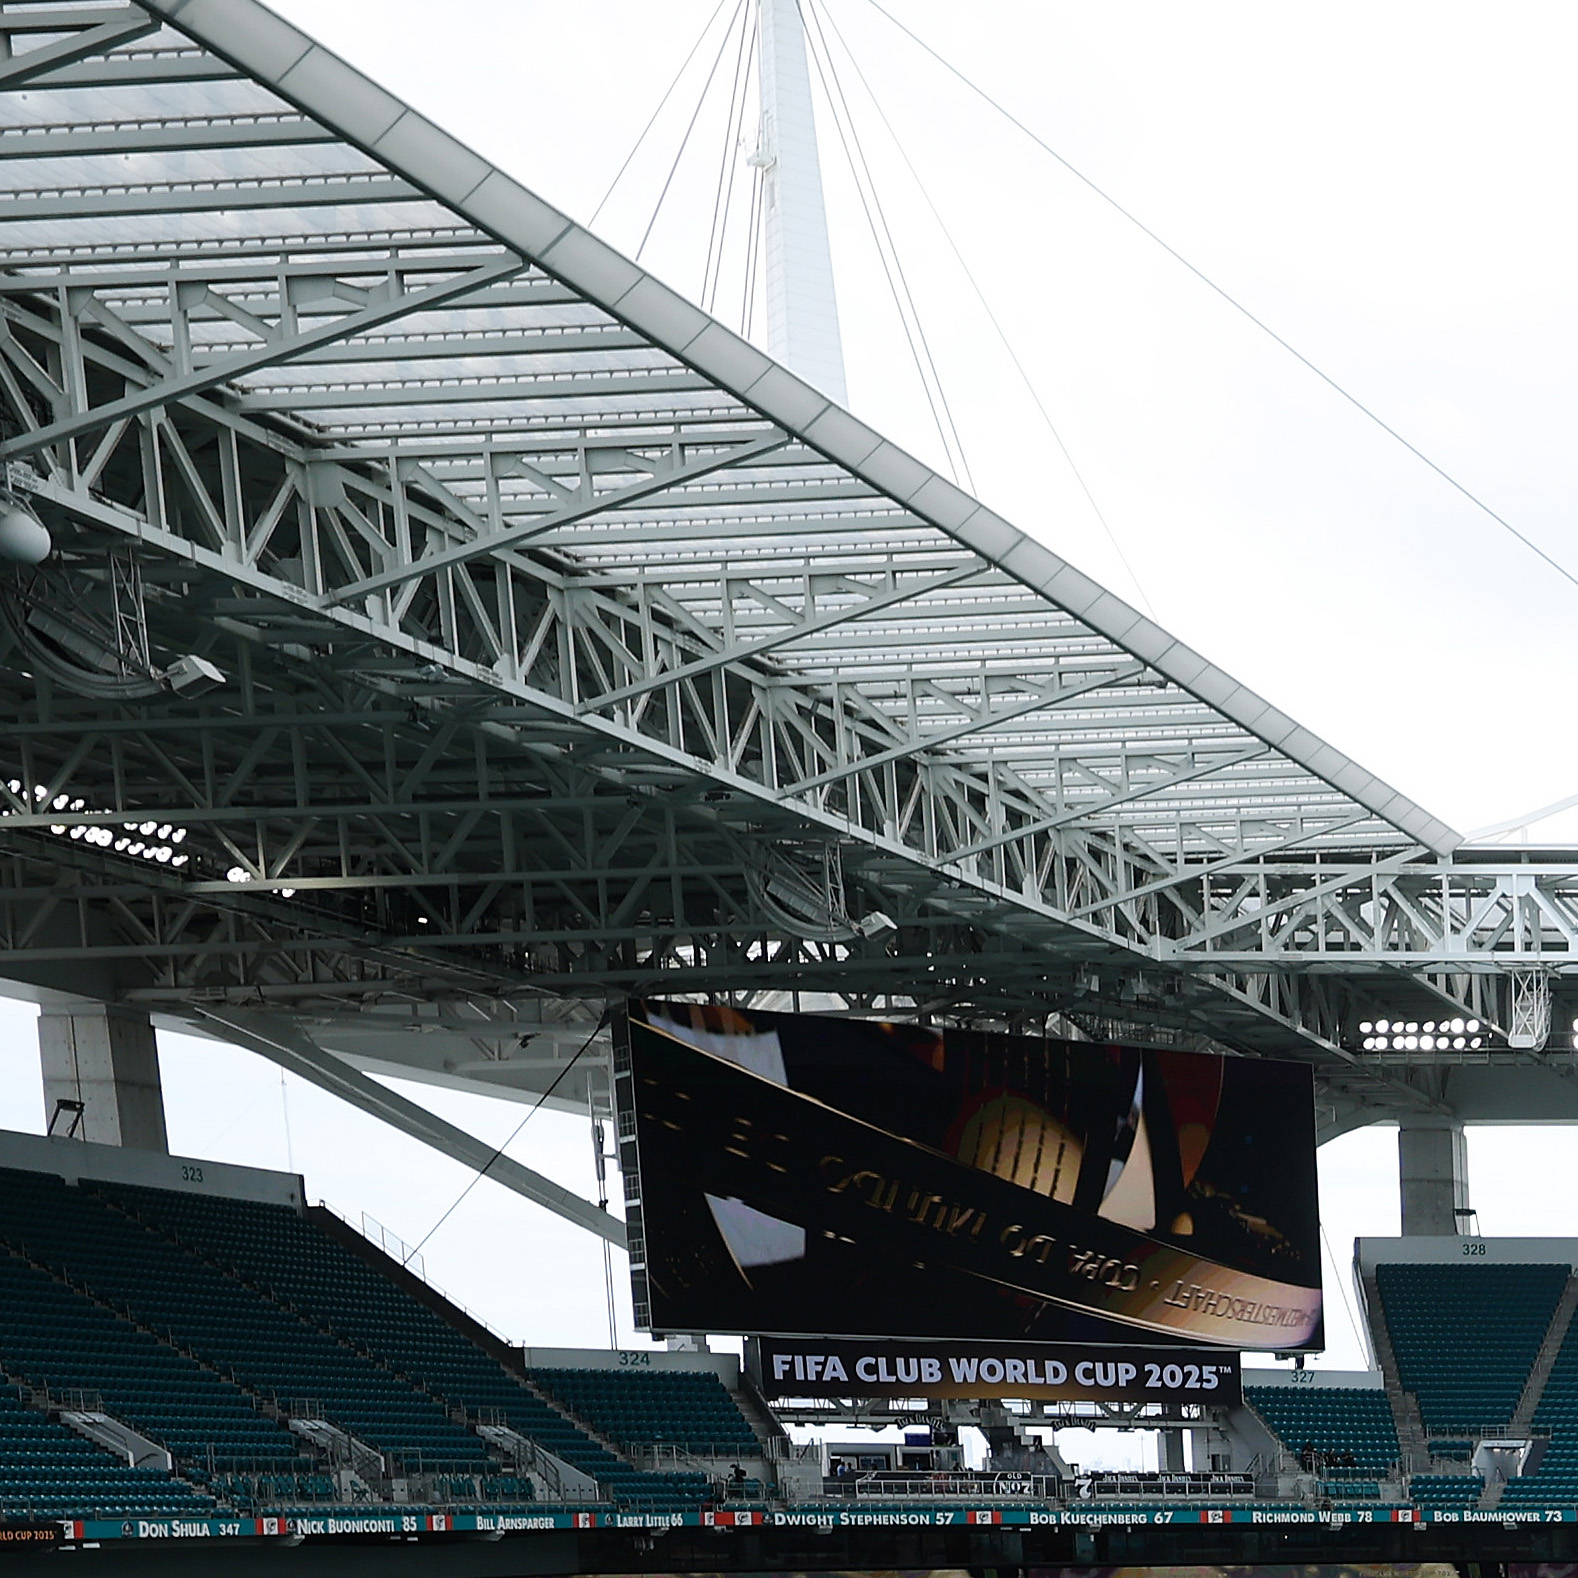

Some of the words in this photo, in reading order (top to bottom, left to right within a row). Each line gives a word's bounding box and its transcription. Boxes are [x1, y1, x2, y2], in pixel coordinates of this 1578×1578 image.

[182, 1166, 203, 1183] 323
[1462, 1244, 1486, 1256] 328
[618, 1352, 650, 1366] 324
[772, 1354, 848, 1382] FIFA
[856, 1356, 942, 1383] CLUB
[948, 1357, 1067, 1385] WORLD
[1074, 1361, 1137, 1388] CUP
[1291, 1371, 1315, 1384] 327
[1074, 1477, 1094, 1499] 7
[476, 1515, 496, 1530] BILL
[497, 1514, 555, 1530] ARNSPARGER
[617, 1513, 644, 1528] LARRY
[645, 1513, 670, 1528] LITTLE
[670, 1513, 683, 1526] 66
[774, 1513, 834, 1526] DWIGHT
[840, 1513, 930, 1526] STEPHENSON
[935, 1512, 954, 1525] 57
[1030, 1513, 1056, 1525] BOB
[1060, 1511, 1147, 1525] KUECHENBERG
[1153, 1511, 1173, 1524] 67
[1252, 1512, 1315, 1523] RICHMOND
[1318, 1511, 1351, 1523] WEBB
[1357, 1511, 1373, 1523] 78
[1433, 1511, 1459, 1522] BOB
[1463, 1511, 1541, 1522] BAUMHOWER
[1545, 1511, 1562, 1522] 73
[139, 1523, 168, 1538] DON
[171, 1523, 210, 1537] SHULA
[219, 1523, 240, 1536] 347
[297, 1518, 325, 1535] NICK
[328, 1518, 395, 1534] BUONICONTI
[403, 1517, 417, 1532] 85
[15, 1531, 32, 1541] CUP
